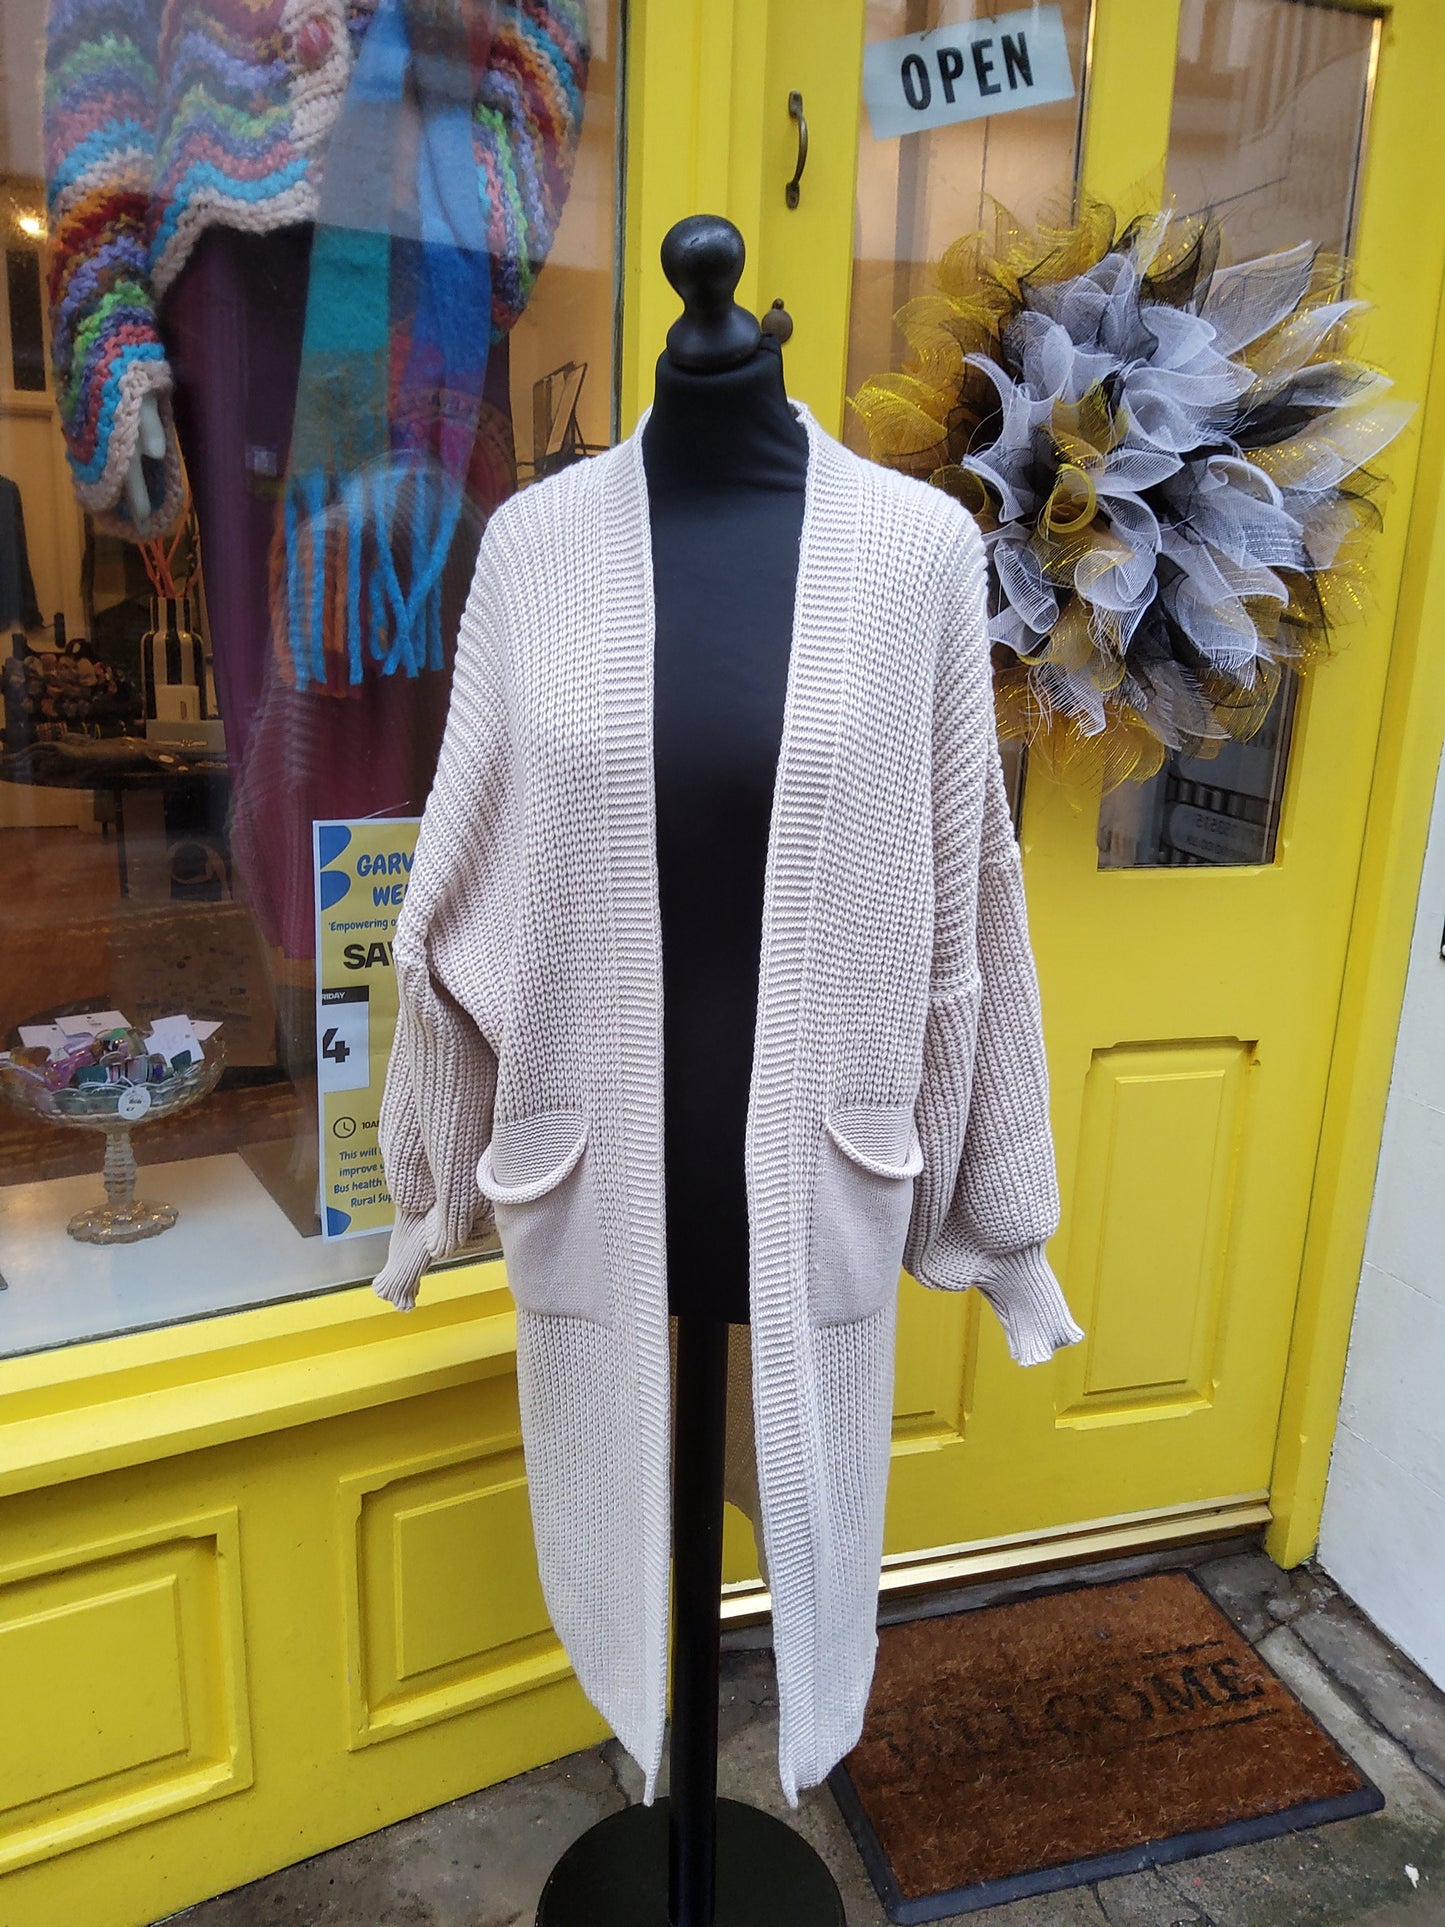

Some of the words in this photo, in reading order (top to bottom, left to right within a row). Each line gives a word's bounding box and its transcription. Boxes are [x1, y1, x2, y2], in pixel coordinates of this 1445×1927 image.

[901, 31, 1034, 110] OPEN
[372, 883, 409, 907] WE
[322, 1027, 350, 1064] 4
[339, 1151, 357, 1160] This
[359, 1148, 377, 1157] will
[339, 1164, 377, 1178] improve
[334, 1184, 349, 1194] Bus
[352, 1178, 382, 1190] health
[351, 1195, 375, 1207] Rural
